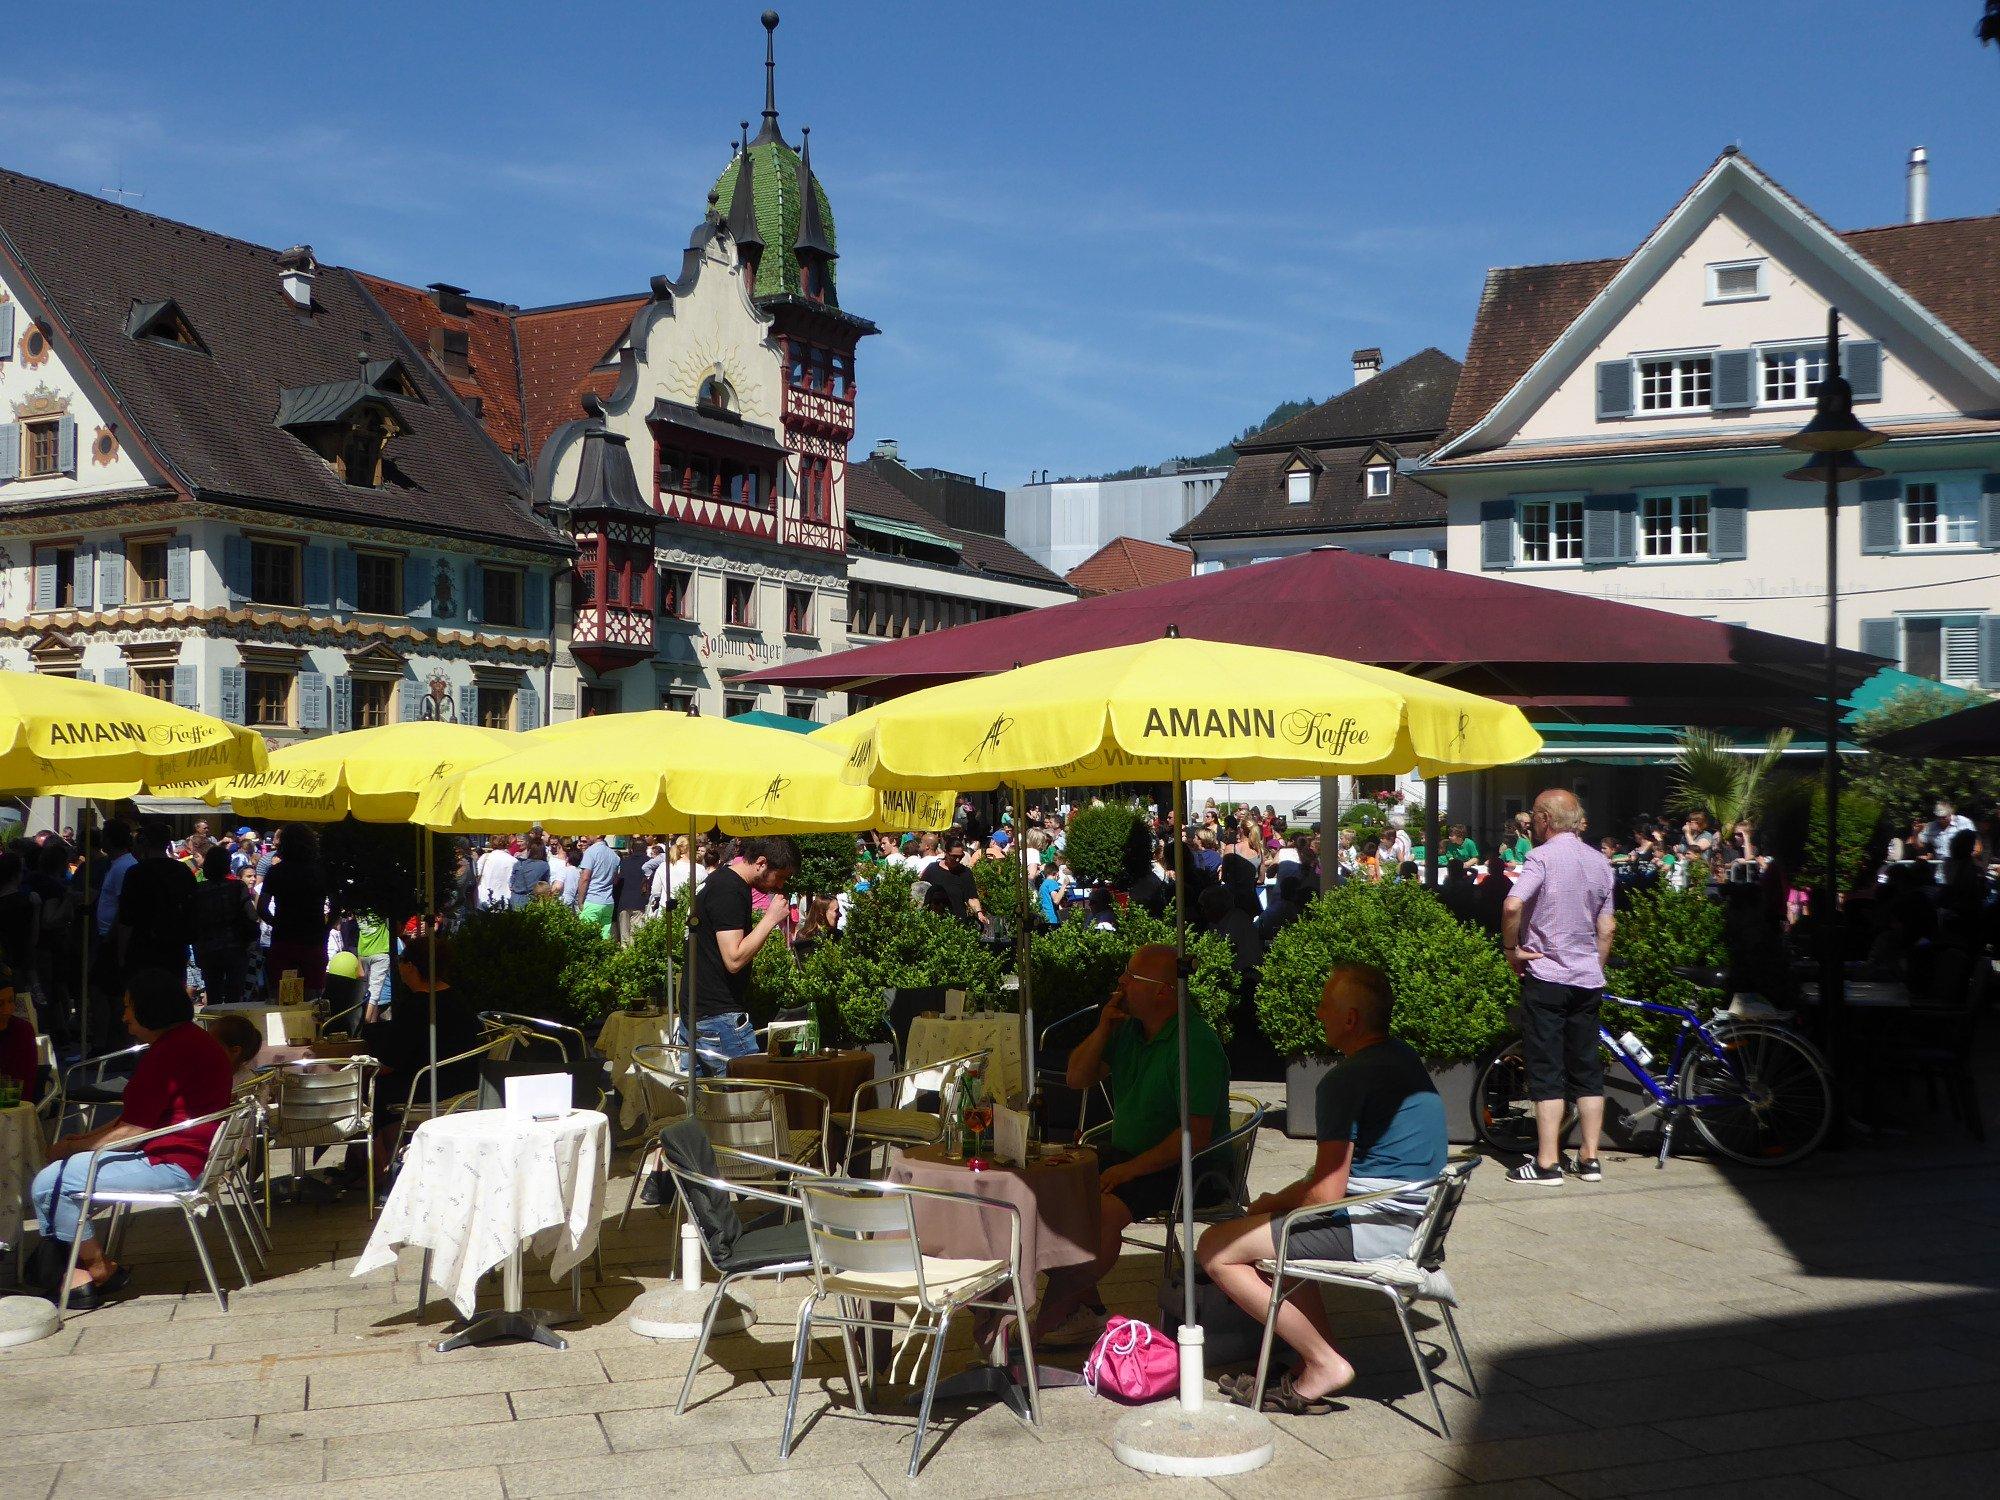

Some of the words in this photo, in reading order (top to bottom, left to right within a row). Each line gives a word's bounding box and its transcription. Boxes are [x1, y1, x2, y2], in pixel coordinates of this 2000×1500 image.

[700, 631, 745, 658] Johann
[51, 721, 146, 745] AMANN
[147, 723, 217, 746] Kaffee
[1142, 707, 1276, 738] AMANN
[1280, 708, 1370, 756] Kaffee
[225, 769, 291, 789] AMANN
[484, 779, 579, 806] AMANN
[579, 778, 640, 813] Kaffee
